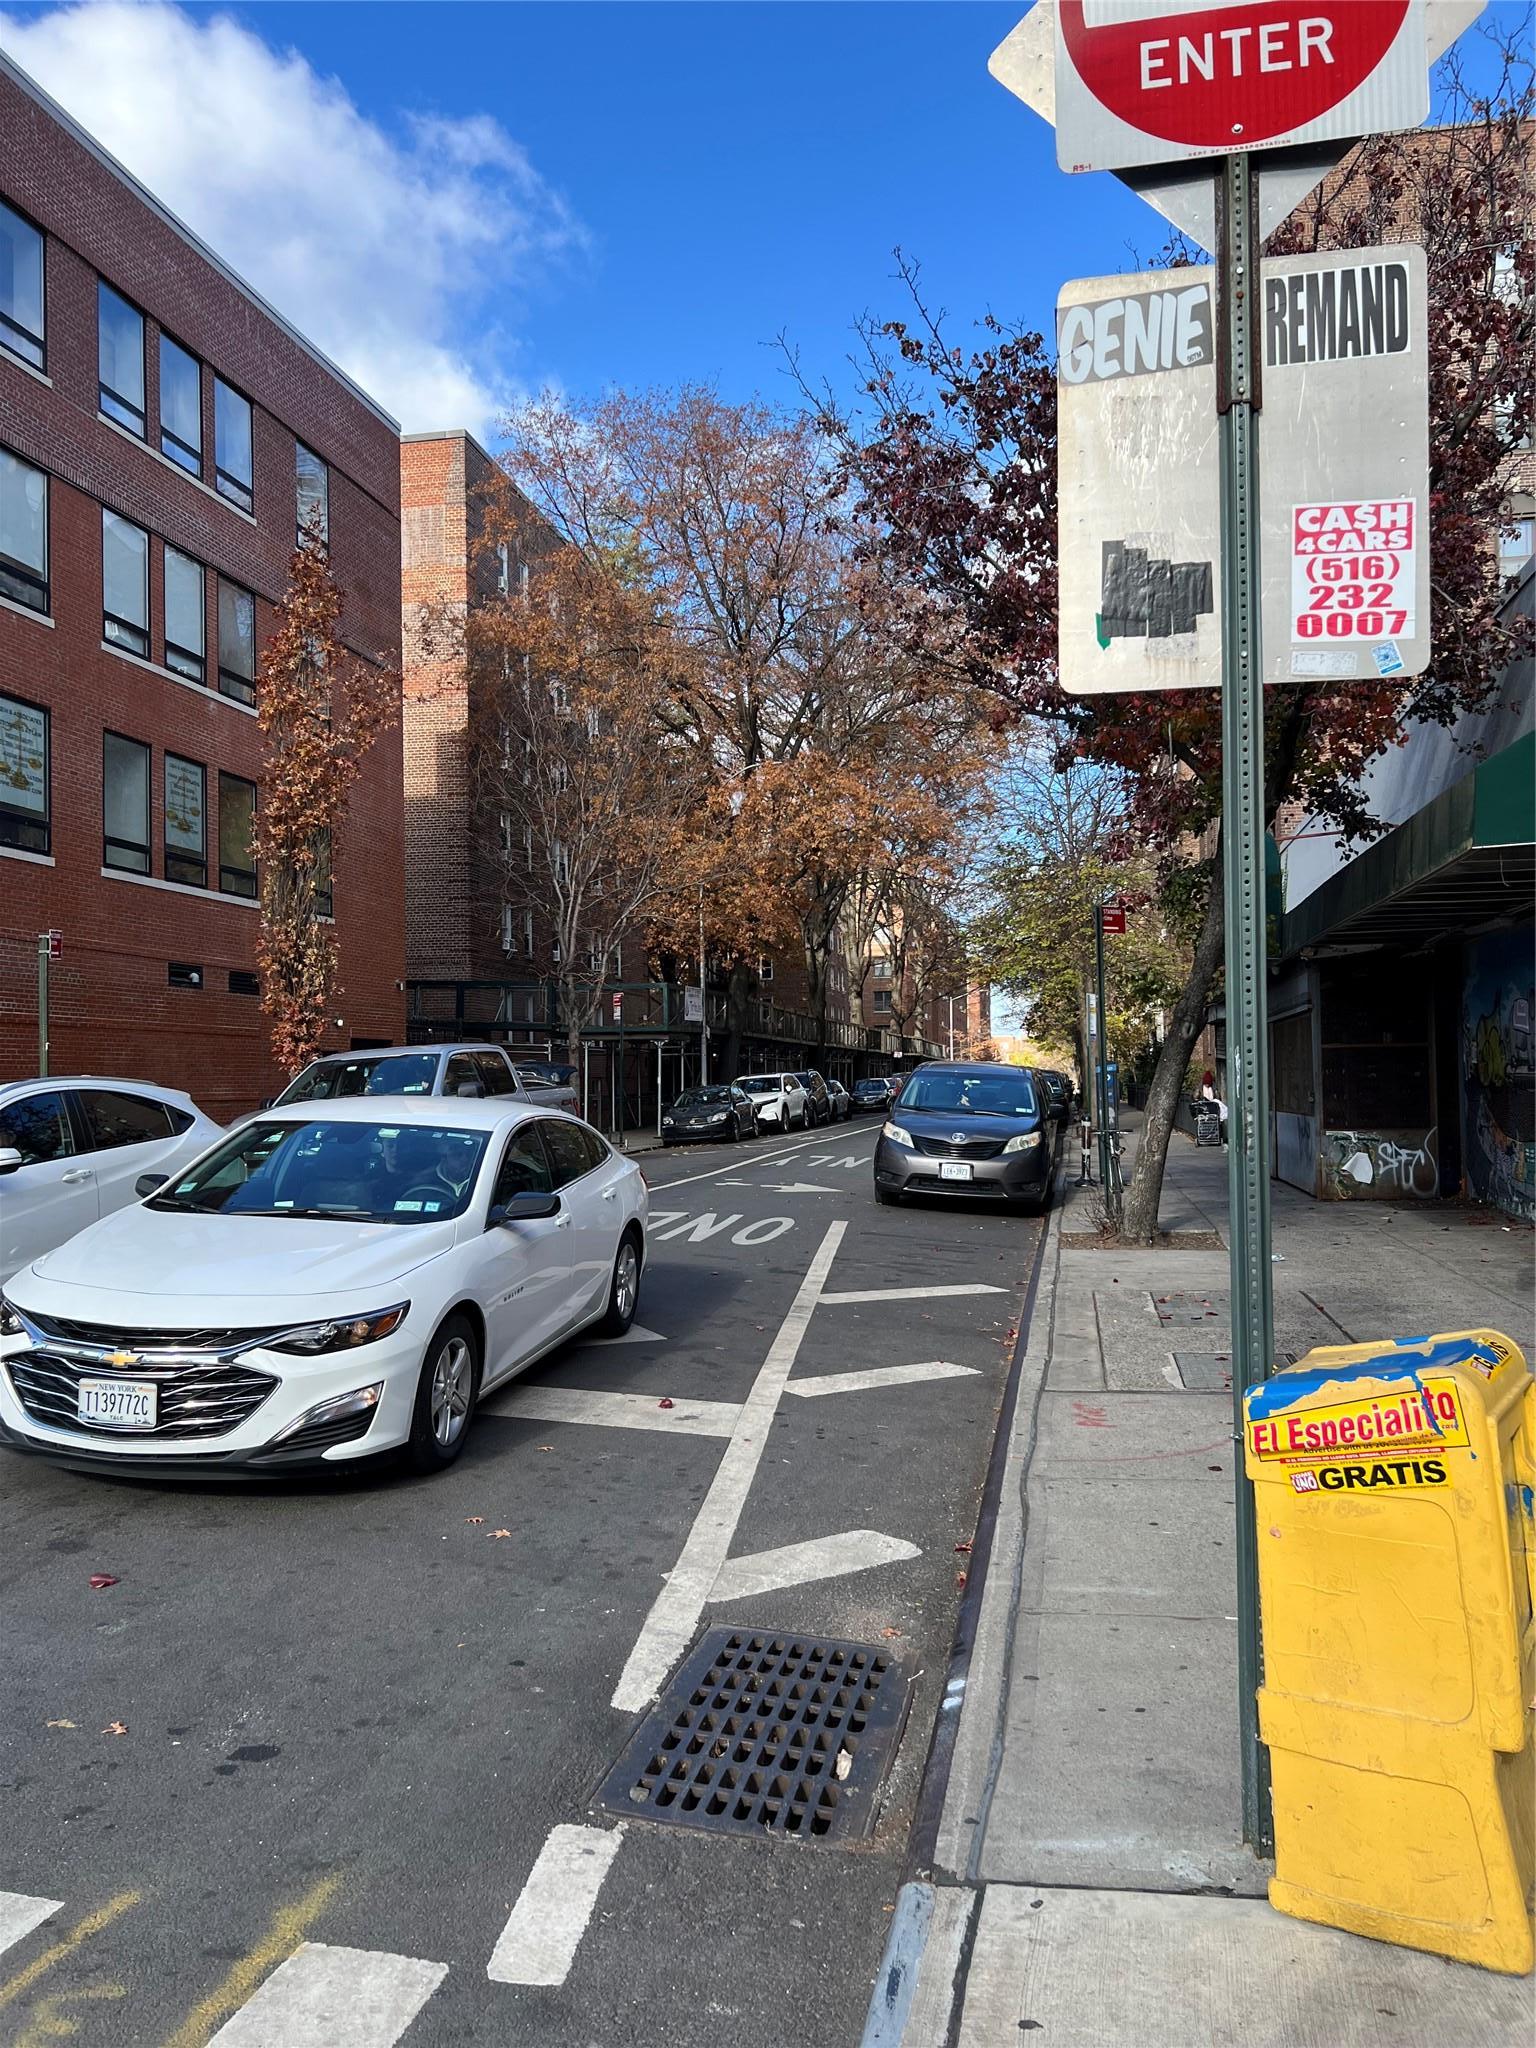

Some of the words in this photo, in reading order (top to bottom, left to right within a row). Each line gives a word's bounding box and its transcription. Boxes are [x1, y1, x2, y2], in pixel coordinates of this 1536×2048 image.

[1139, 17, 1334, 90] ENTER
[1266, 263, 1408, 367] REMAND
[1059, 284, 1208, 384] GENIE
[1306, 553, 1400, 583] (516)
[1309, 582, 1394, 610] 232
[1297, 610, 1407, 638] 0007
[647, 1211, 796, 1245] ONL
[85, 1391, 149, 1416] T139772C
[98, 1383, 116, 1391] NEW
[117, 1384, 137, 1393] YORK
[1253, 1421, 1279, 1453] El
[1291, 1475, 1318, 1491] UNO
[1318, 1460, 1447, 1490] GRATIS
